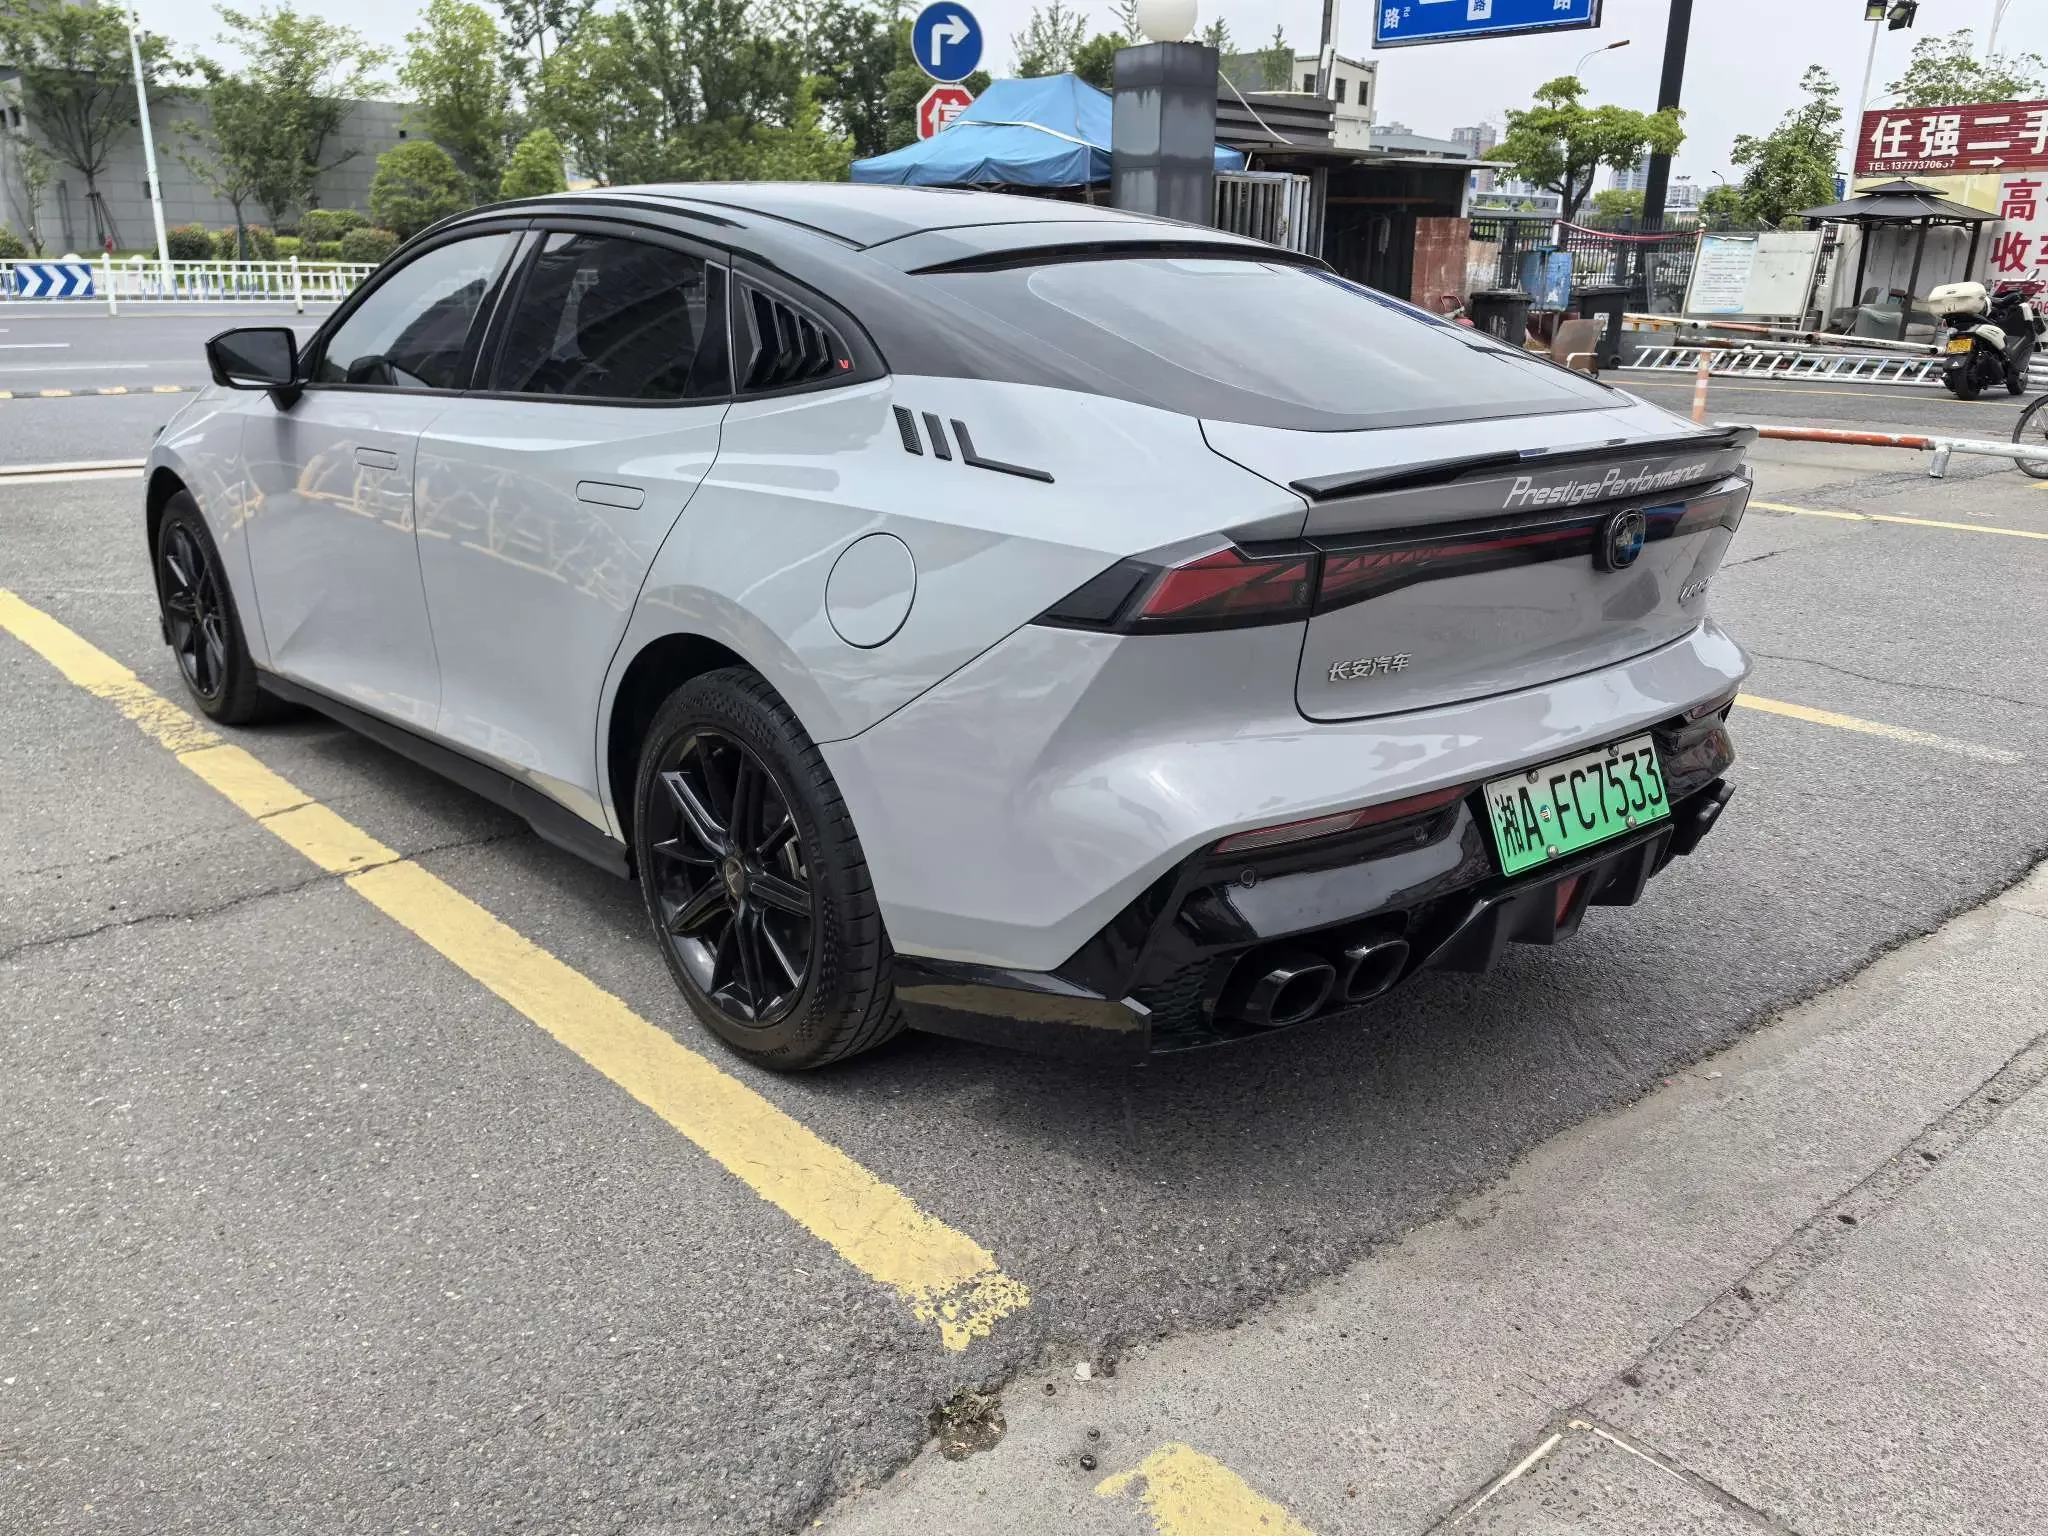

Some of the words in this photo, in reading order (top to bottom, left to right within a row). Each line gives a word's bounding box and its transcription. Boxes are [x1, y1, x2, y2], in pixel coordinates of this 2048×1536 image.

[1403, 6, 1411, 18] Rd
[1473, 0, 1487, 12] 路
[1383, 7, 1400, 29] 路
[1328, 652, 1412, 682] 长安汽车
